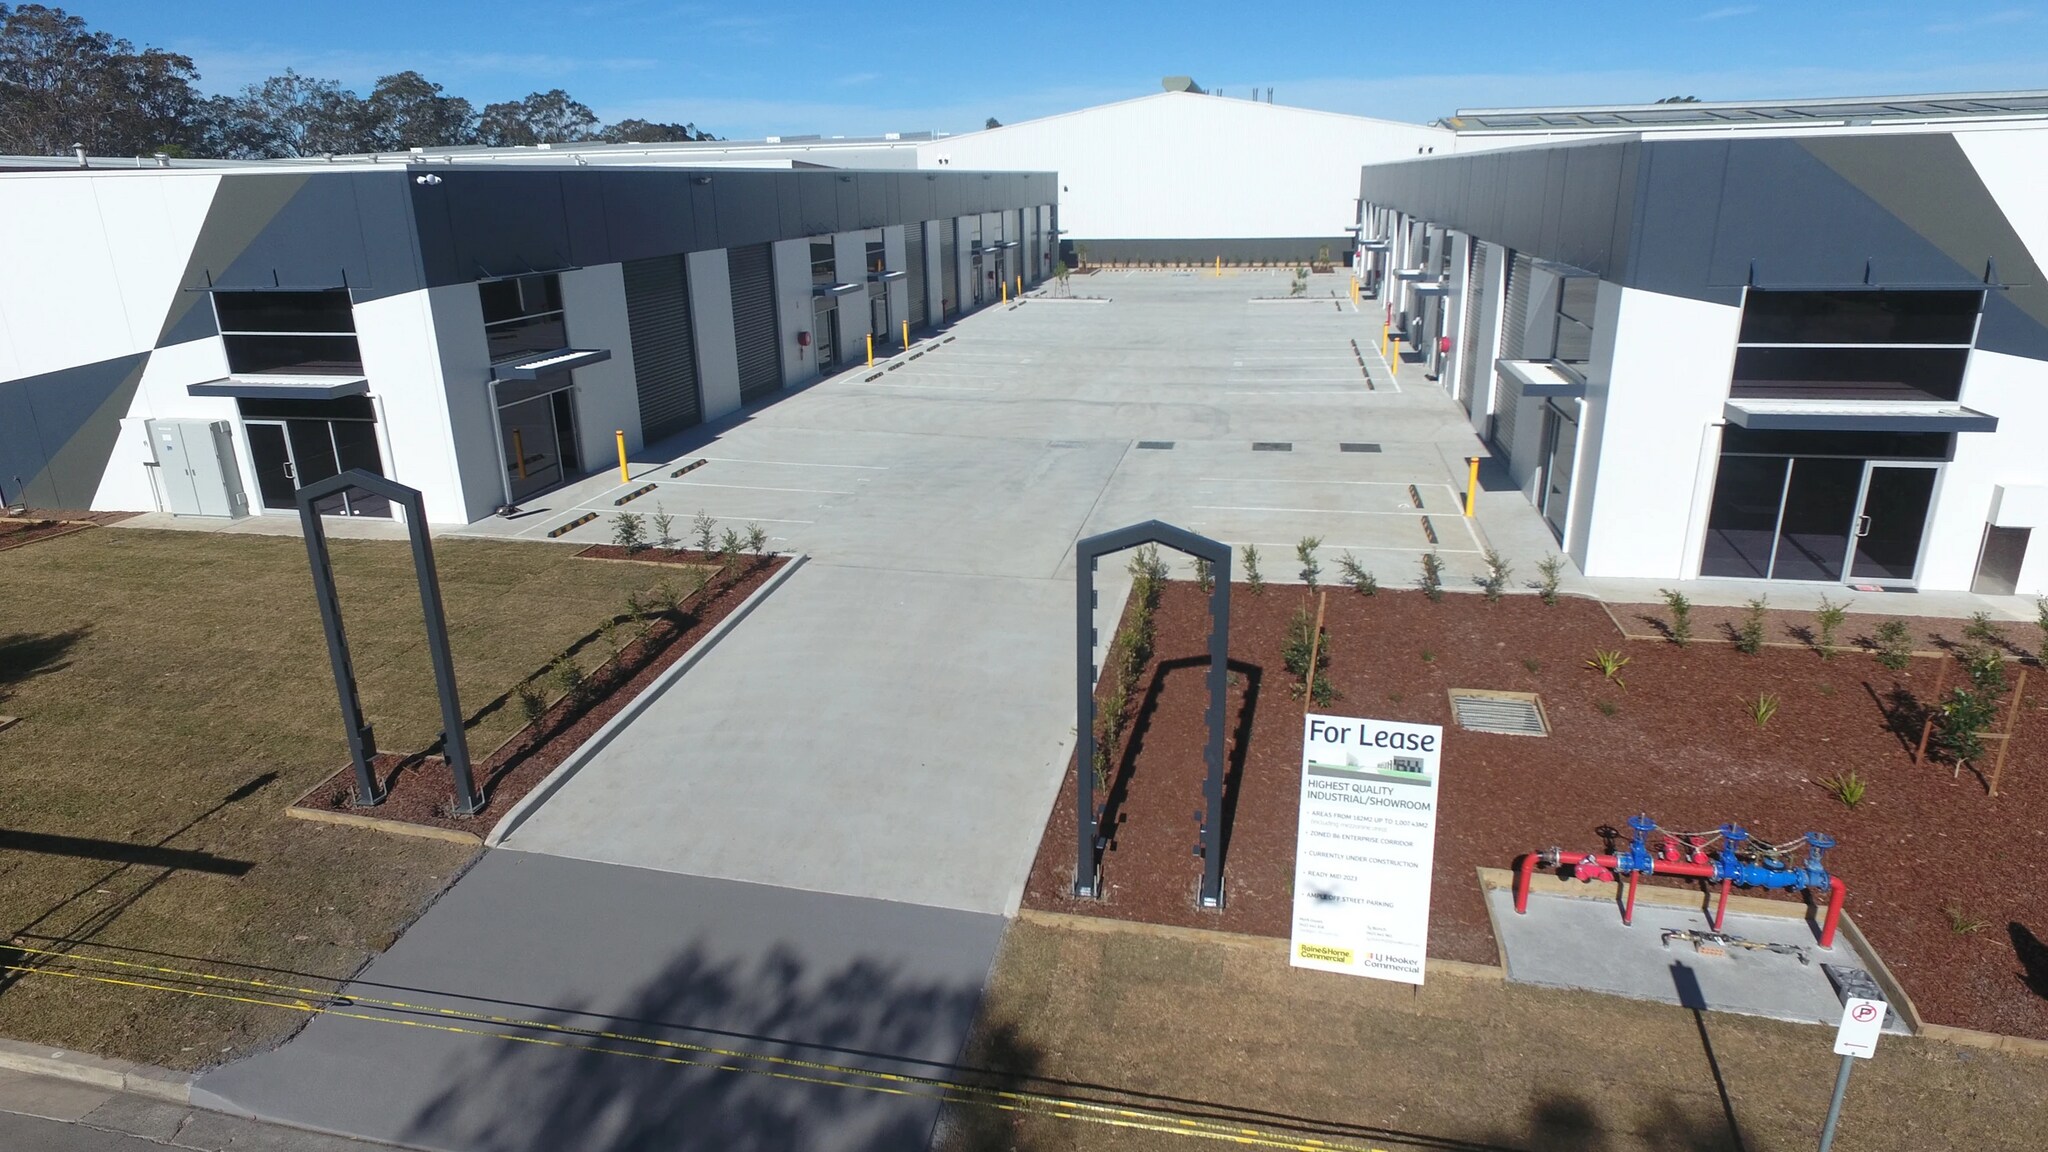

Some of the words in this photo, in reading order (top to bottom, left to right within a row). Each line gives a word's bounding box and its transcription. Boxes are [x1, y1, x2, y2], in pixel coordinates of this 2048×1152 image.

[1310, 720, 1351, 744] For
[1360, 724, 1435, 752] Lease
[1308, 779, 1350, 791] HIGHEST
[1352, 784, 1394, 796] QUALITY
[1307, 790, 1431, 811] INDUSTRIAL/SHOWROOM
[1334, 812, 1352, 820] FROM
[1374, 816, 1384, 824] UP
[1310, 830, 1331, 838] ZONED
[1342, 834, 1379, 844] ENTERPRISE
[1380, 838, 1414, 847] CORRIDOR
[1309, 850, 1344, 860] CURRENTLY
[1346, 855, 1368, 863] UNDER
[1369, 857, 1419, 868] CONSTRUCTION
[1342, 896, 1365, 904] STREET
[1366, 899, 1394, 908] PARKING
[1301, 951, 1345, 963] Commercial
[1375, 953, 1384, 961] LJ
[1385, 955, 1418, 965] Hooker
[1364, 960, 1420, 974] Commercial
